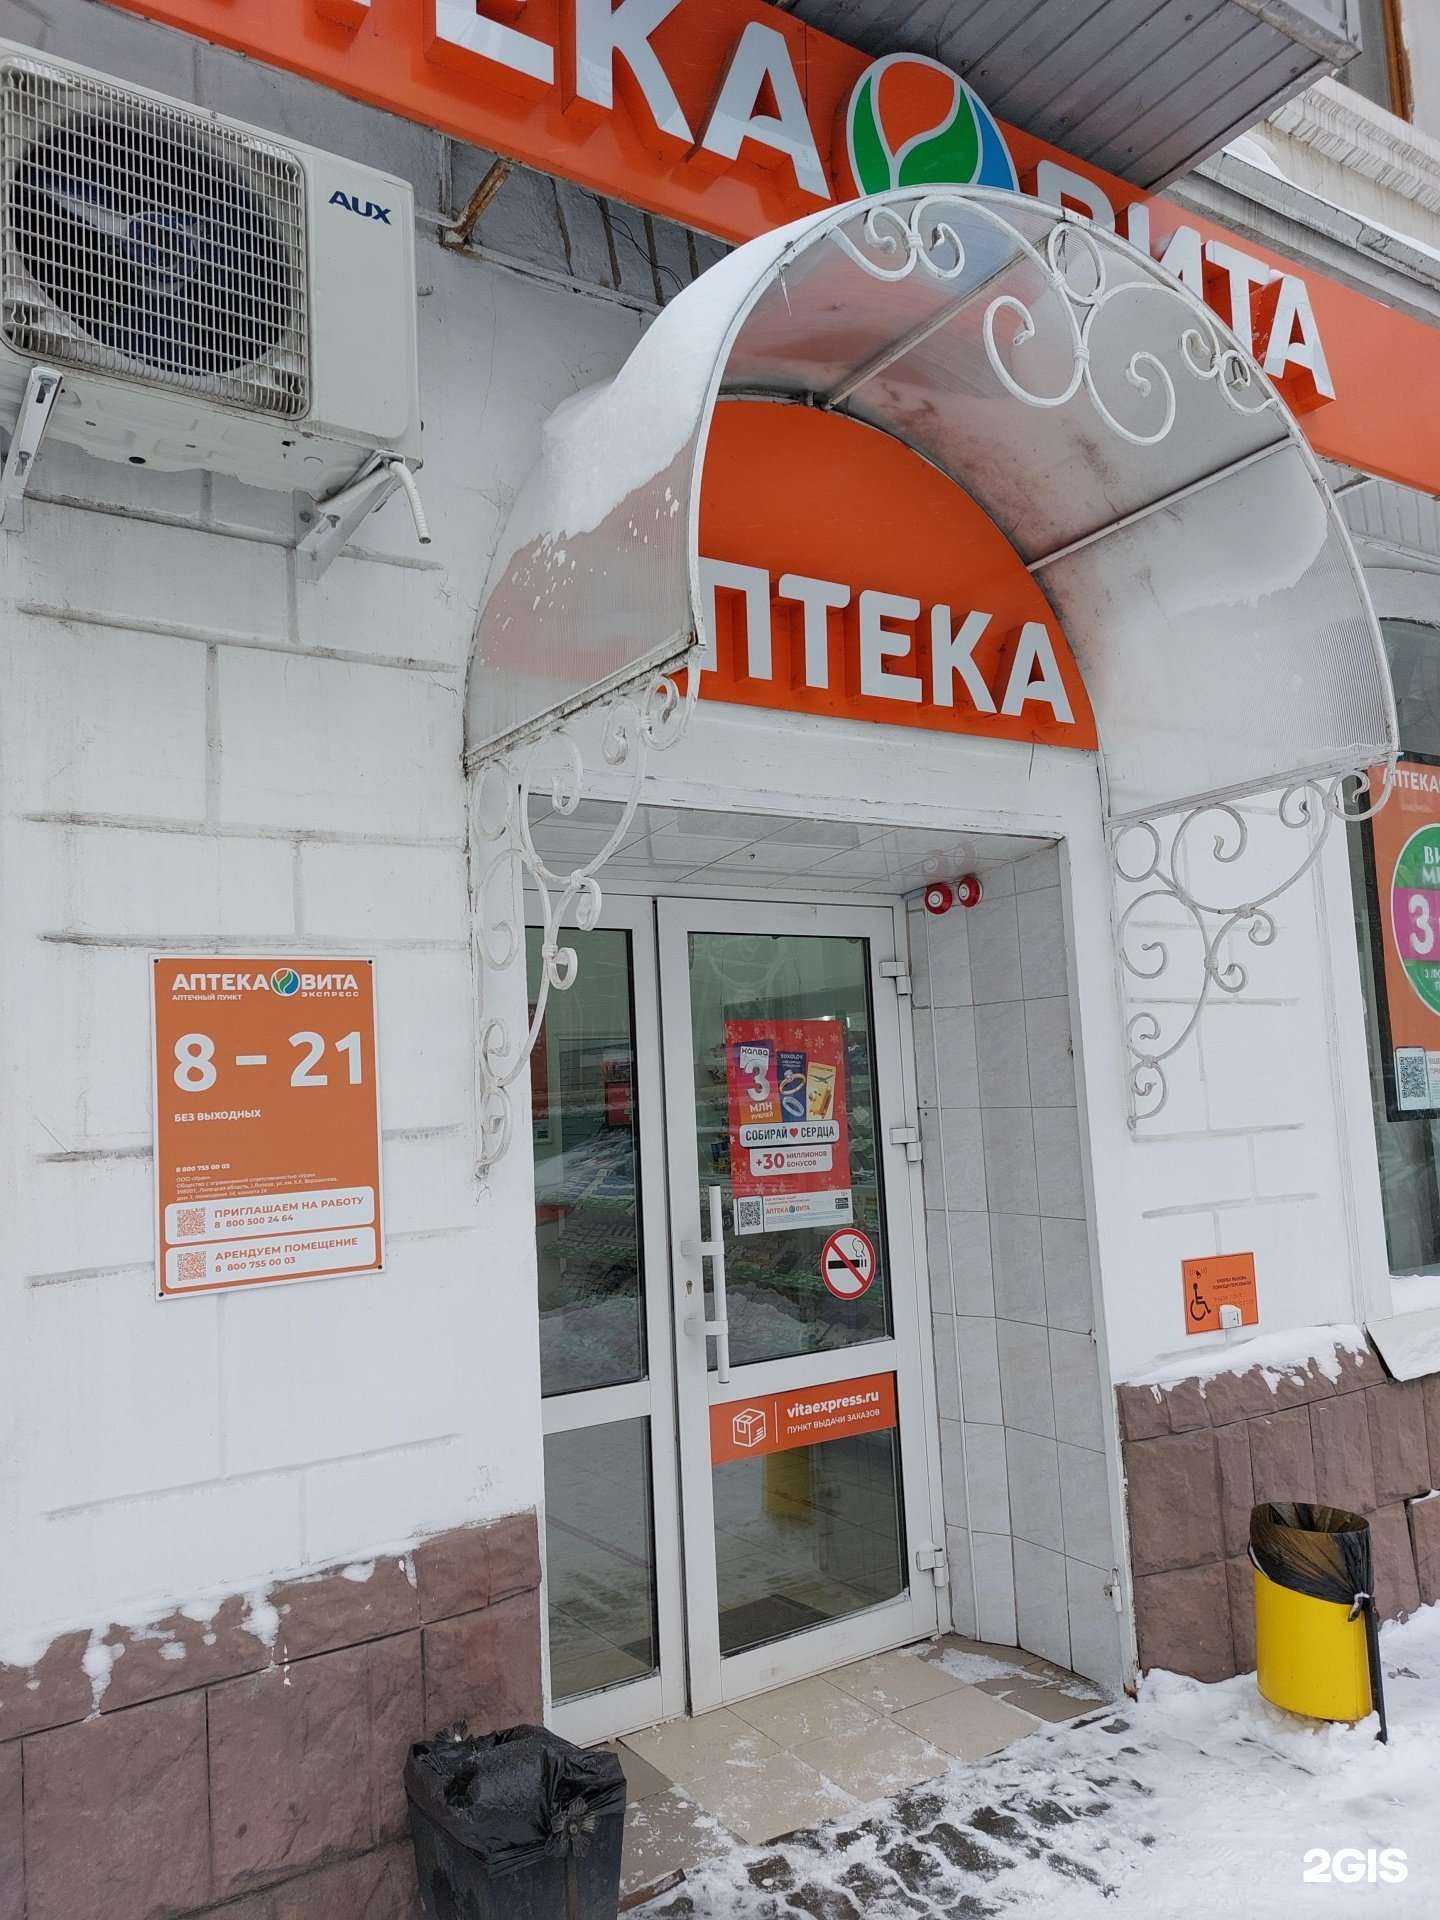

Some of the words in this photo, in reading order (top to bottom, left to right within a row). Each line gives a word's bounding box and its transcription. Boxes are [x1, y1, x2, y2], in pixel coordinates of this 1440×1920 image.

[328, 190, 392, 225] AUX
[1408, 894, 1434, 954] 3
[172, 973, 270, 991] АПТЕКА
[301, 974, 359, 990] ВИТА
[216, 993, 242, 1001] ПУНКТ
[173, 1033, 217, 1092] 8
[288, 1031, 362, 1087] 21
[746, 1063, 770, 1102] 3
[174, 1113, 195, 1122] БЕЗ
[197, 1109, 262, 1121] ВЫХОДНЫХ
[749, 1102, 773, 1113] МЛН
[746, 1126, 788, 1141] СОБИРАЙ
[801, 1126, 835, 1138] СЕРДЦА
[756, 1153, 785, 1170] +30
[786, 1151, 828, 1159] МИЛЛИОНОВ
[214, 1202, 299, 1218] ПРИГЛАШАЕМ
[301, 1199, 319, 1210] НА
[321, 1196, 364, 1209] РАБОТУ
[214, 1221, 221, 1229] 8
[225, 1218, 245, 1228] 800
[267, 1215, 280, 1224] 24
[281, 1214, 294, 1222] 64
[215, 1246, 281, 1261] АРЕНДУЕМ
[284, 1237, 359, 1254] ПОМЕЩЕНИЕ
[215, 1264, 222, 1273] 8
[227, 1261, 247, 1271] 800
[249, 1260, 266, 1269] 755
[269, 1258, 282, 1266] 00
[284, 1256, 296, 1264] 03
[787, 1391, 879, 1418] vitaexpress.ru
[787, 1422, 812, 1434] ПУНКТ
[813, 1416, 846, 1429] ВЫДАЧИ
[847, 1409, 880, 1422] ЗАКАЗОВ
